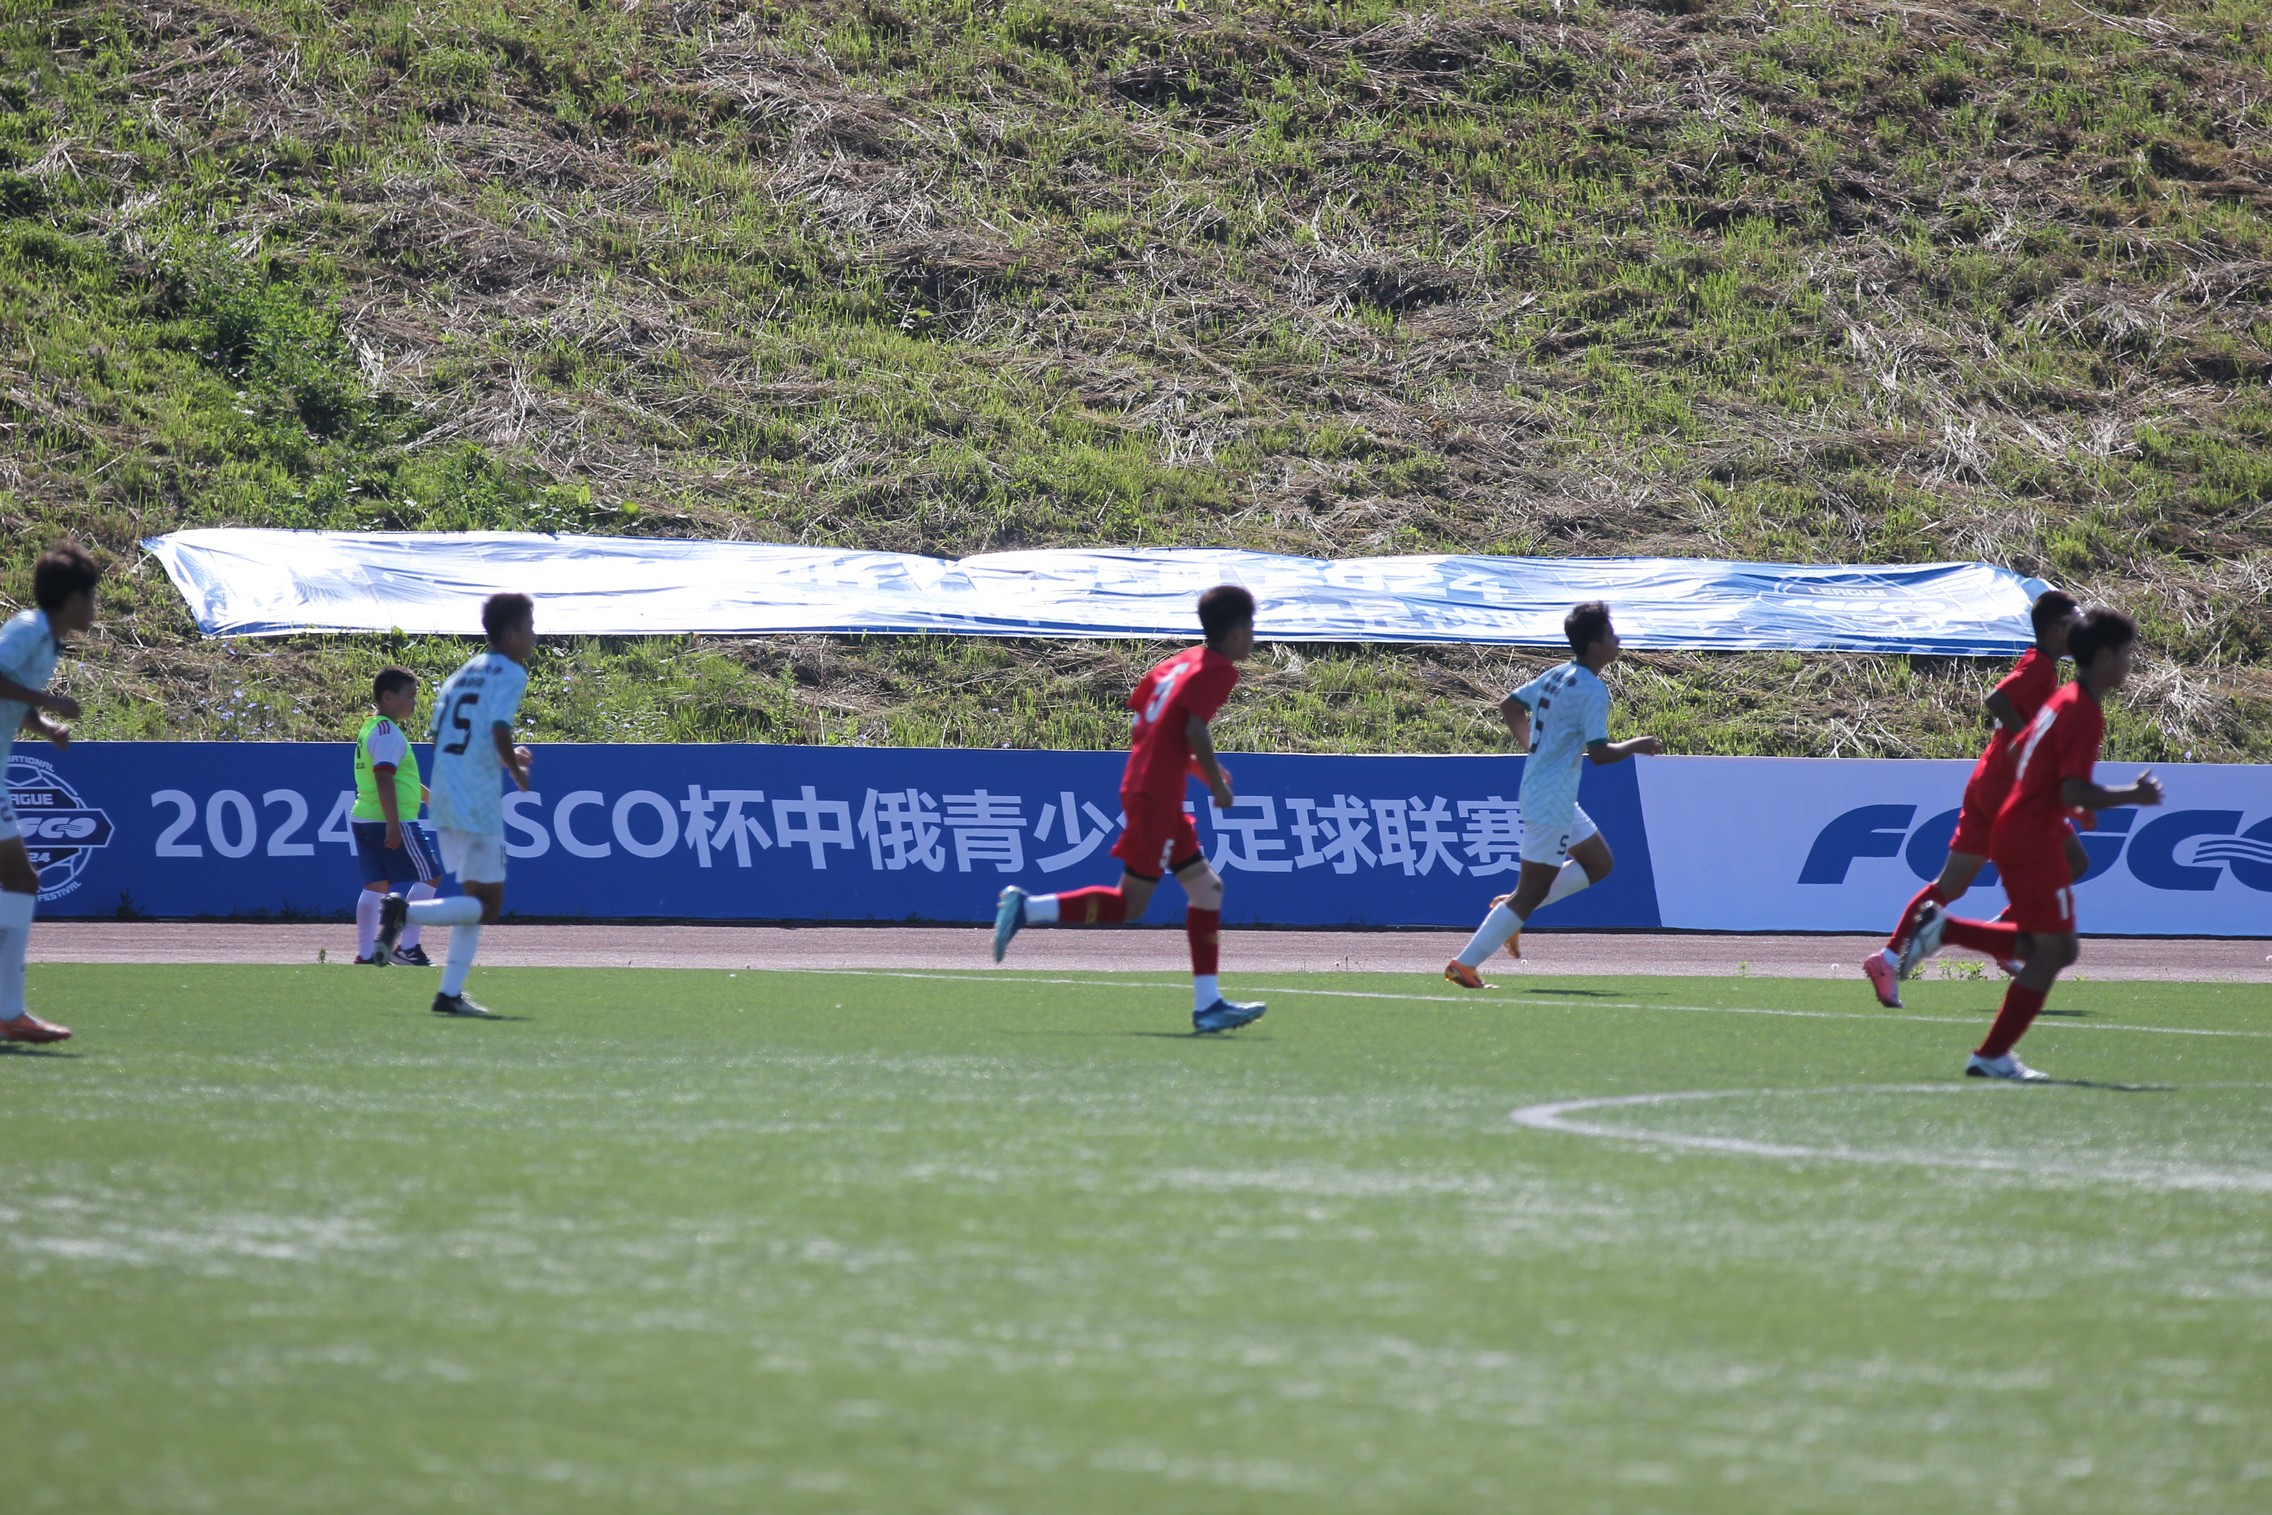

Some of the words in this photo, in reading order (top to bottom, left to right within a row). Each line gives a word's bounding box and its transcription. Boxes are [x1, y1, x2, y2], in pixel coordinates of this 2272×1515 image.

[1807, 586, 1888, 598] LEAGUE
[9, 793, 54, 806] AGUE
[150, 788, 358, 859] 2024
[417, 784, 1525, 878] SCO杯中俄青少足球联赛
[1556, 833, 1571, 856] 5
[28, 852, 51, 864] 24
[37, 880, 83, 902] FESTIVAL
